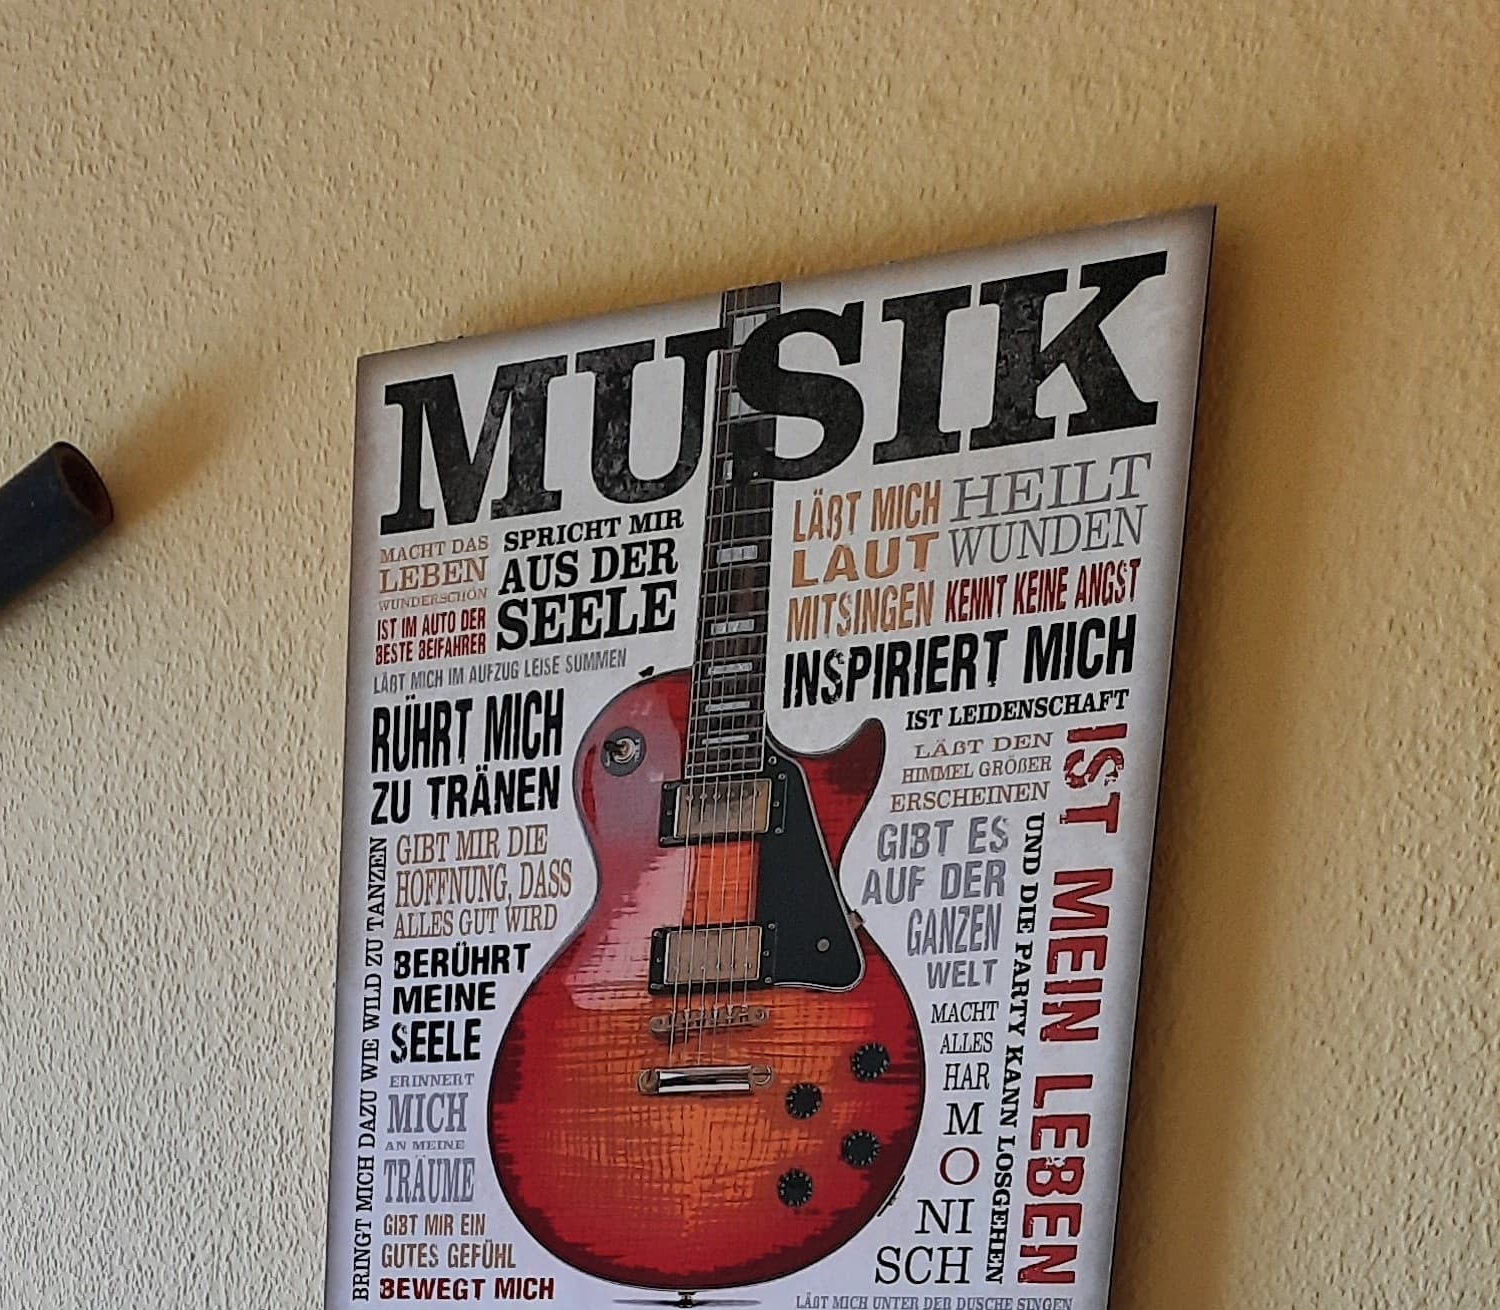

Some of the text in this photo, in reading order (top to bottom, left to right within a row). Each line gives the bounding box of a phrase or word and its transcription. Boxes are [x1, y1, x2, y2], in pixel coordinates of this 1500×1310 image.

[379, 250, 1169, 536] MUSIK
[871, 480, 941, 533] MICH
[950, 452, 1152, 523] HEILT
[380, 535, 489, 564] MACHT DAS
[503, 507, 684, 553] SPRICHT MIR
[950, 504, 1148, 568] WUNDEN
[379, 556, 489, 594] LEBEN
[498, 537, 678, 596] AUS DER
[791, 532, 939, 589] LAUT
[786, 579, 934, 642] MITSINGEN
[945, 558, 1141, 624] KENNT KEINE ANGST
[377, 607, 486, 641] IST IM AUTO DER
[496, 579, 678, 652] SEELE
[375, 632, 486, 666] BESTE BEIFAHRER
[410, 668, 443, 690] MICH
[448, 666, 464, 686] IM
[469, 660, 519, 684] AUFZUG
[523, 654, 560, 678] LEISE
[565, 647, 627, 676] SUMMEN
[782, 614, 1136, 710] INSPIRIERT MICH
[370, 688, 565, 774] RÜHRT MICH
[905, 689, 1129, 731] IST LEIDENSCHAFT
[992, 731, 1054, 753] DEN
[369, 764, 560, 825] ZU TRÄNEN
[901, 762, 974, 785] HIMMEL
[890, 781, 1051, 814] ERSCHEINEN
[395, 824, 548, 866] GIBT MIR DIE
[877, 815, 1009, 863] GIBT ES
[394, 858, 573, 908] HOFFNUNG, DASS
[861, 859, 1006, 906] AUF DER
[393, 903, 558, 940] ALLES GUT WIRD
[907, 903, 1002, 957] GANZEN
[393, 942, 532, 980] BERÜHRT
[927, 958, 998, 990] WELT
[392, 980, 496, 1015] MEINE
[931, 1000, 999, 1025] MACHT
[1017, 723, 1128, 1285] IST MEIN LEBEN
[390, 1018, 482, 1064] SEELE
[940, 1032, 994, 1054] ALLES
[985, 812, 1045, 1285] UND DIE PARTY KANN LOSGEHEN
[352, 836, 387, 1301] BRINGT MICH DAZU WIE WILD ZU TANZEN
[388, 1073, 475, 1089] ERINNERT
[943, 1063, 990, 1091] HAR
[386, 1092, 469, 1135] MICH
[943, 1101, 985, 1136] M
[384, 1139, 466, 1152] AN MEINE
[939, 1146, 980, 1186] O
[383, 1153, 476, 1204] TRÄUME
[383, 1212, 486, 1237] GIBT MIR EIN
[914, 1198, 975, 1235] NI
[381, 1239, 516, 1269] GUTES GEFÜHL
[875, 1245, 973, 1285] SCH
[379, 1276, 555, 1301] BEWEGT MICH
[832, 1295, 868, 1310] MICH
